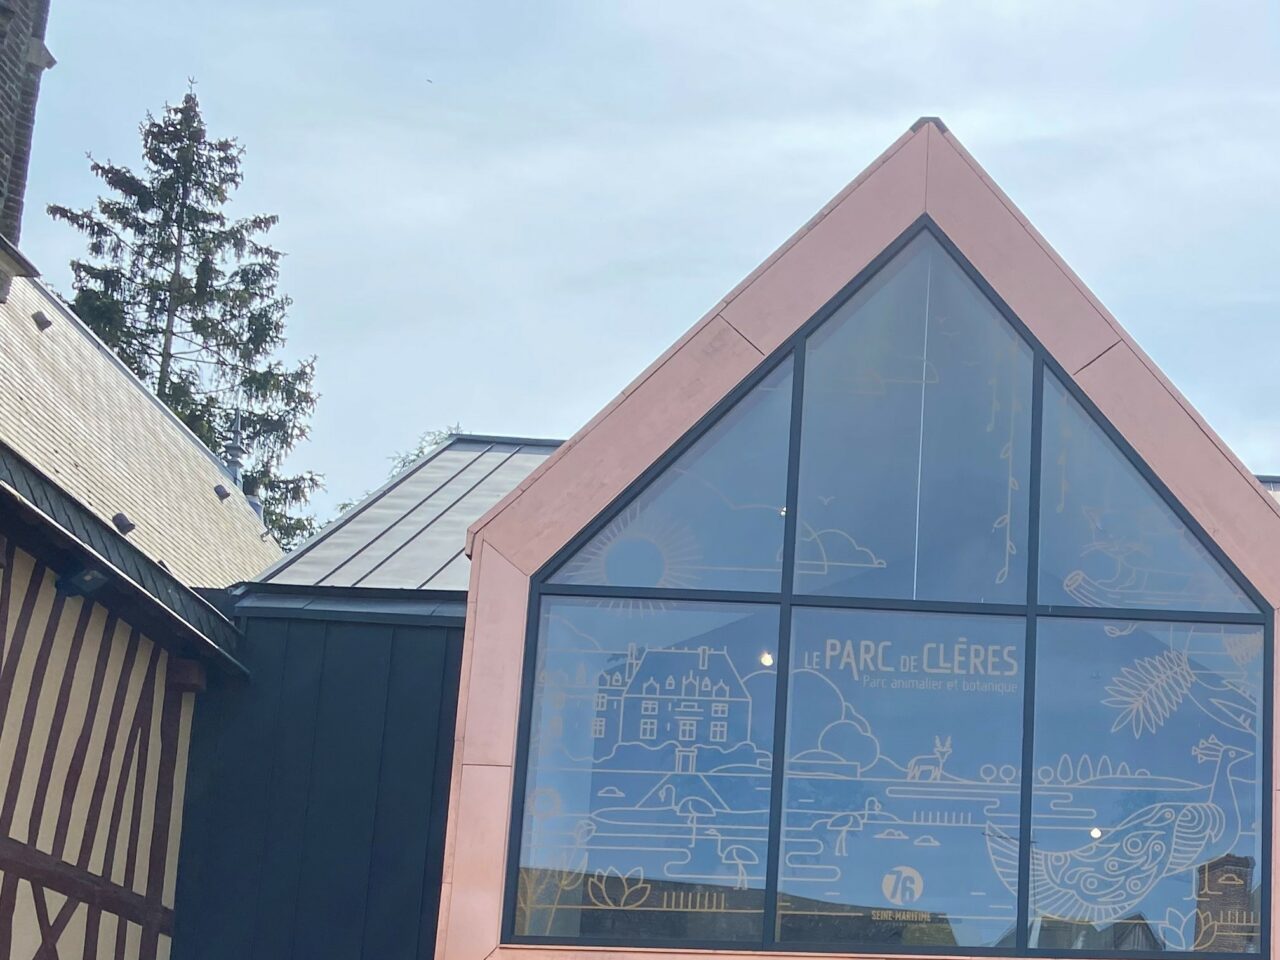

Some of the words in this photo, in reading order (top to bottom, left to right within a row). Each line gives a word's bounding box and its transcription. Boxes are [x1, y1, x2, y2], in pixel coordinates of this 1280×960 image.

[804, 652, 821, 669] LE
[824, 638, 896, 681] PARC
[900, 655, 918, 673] DE
[862, 675, 887, 689] Parc
[890, 677, 943, 690] animalier
[946, 679, 959, 691] et
[961, 680, 1019, 696] botanique
[885, 870, 916, 903] 76
[871, 910, 932, 922] SEINE-MARITIME
